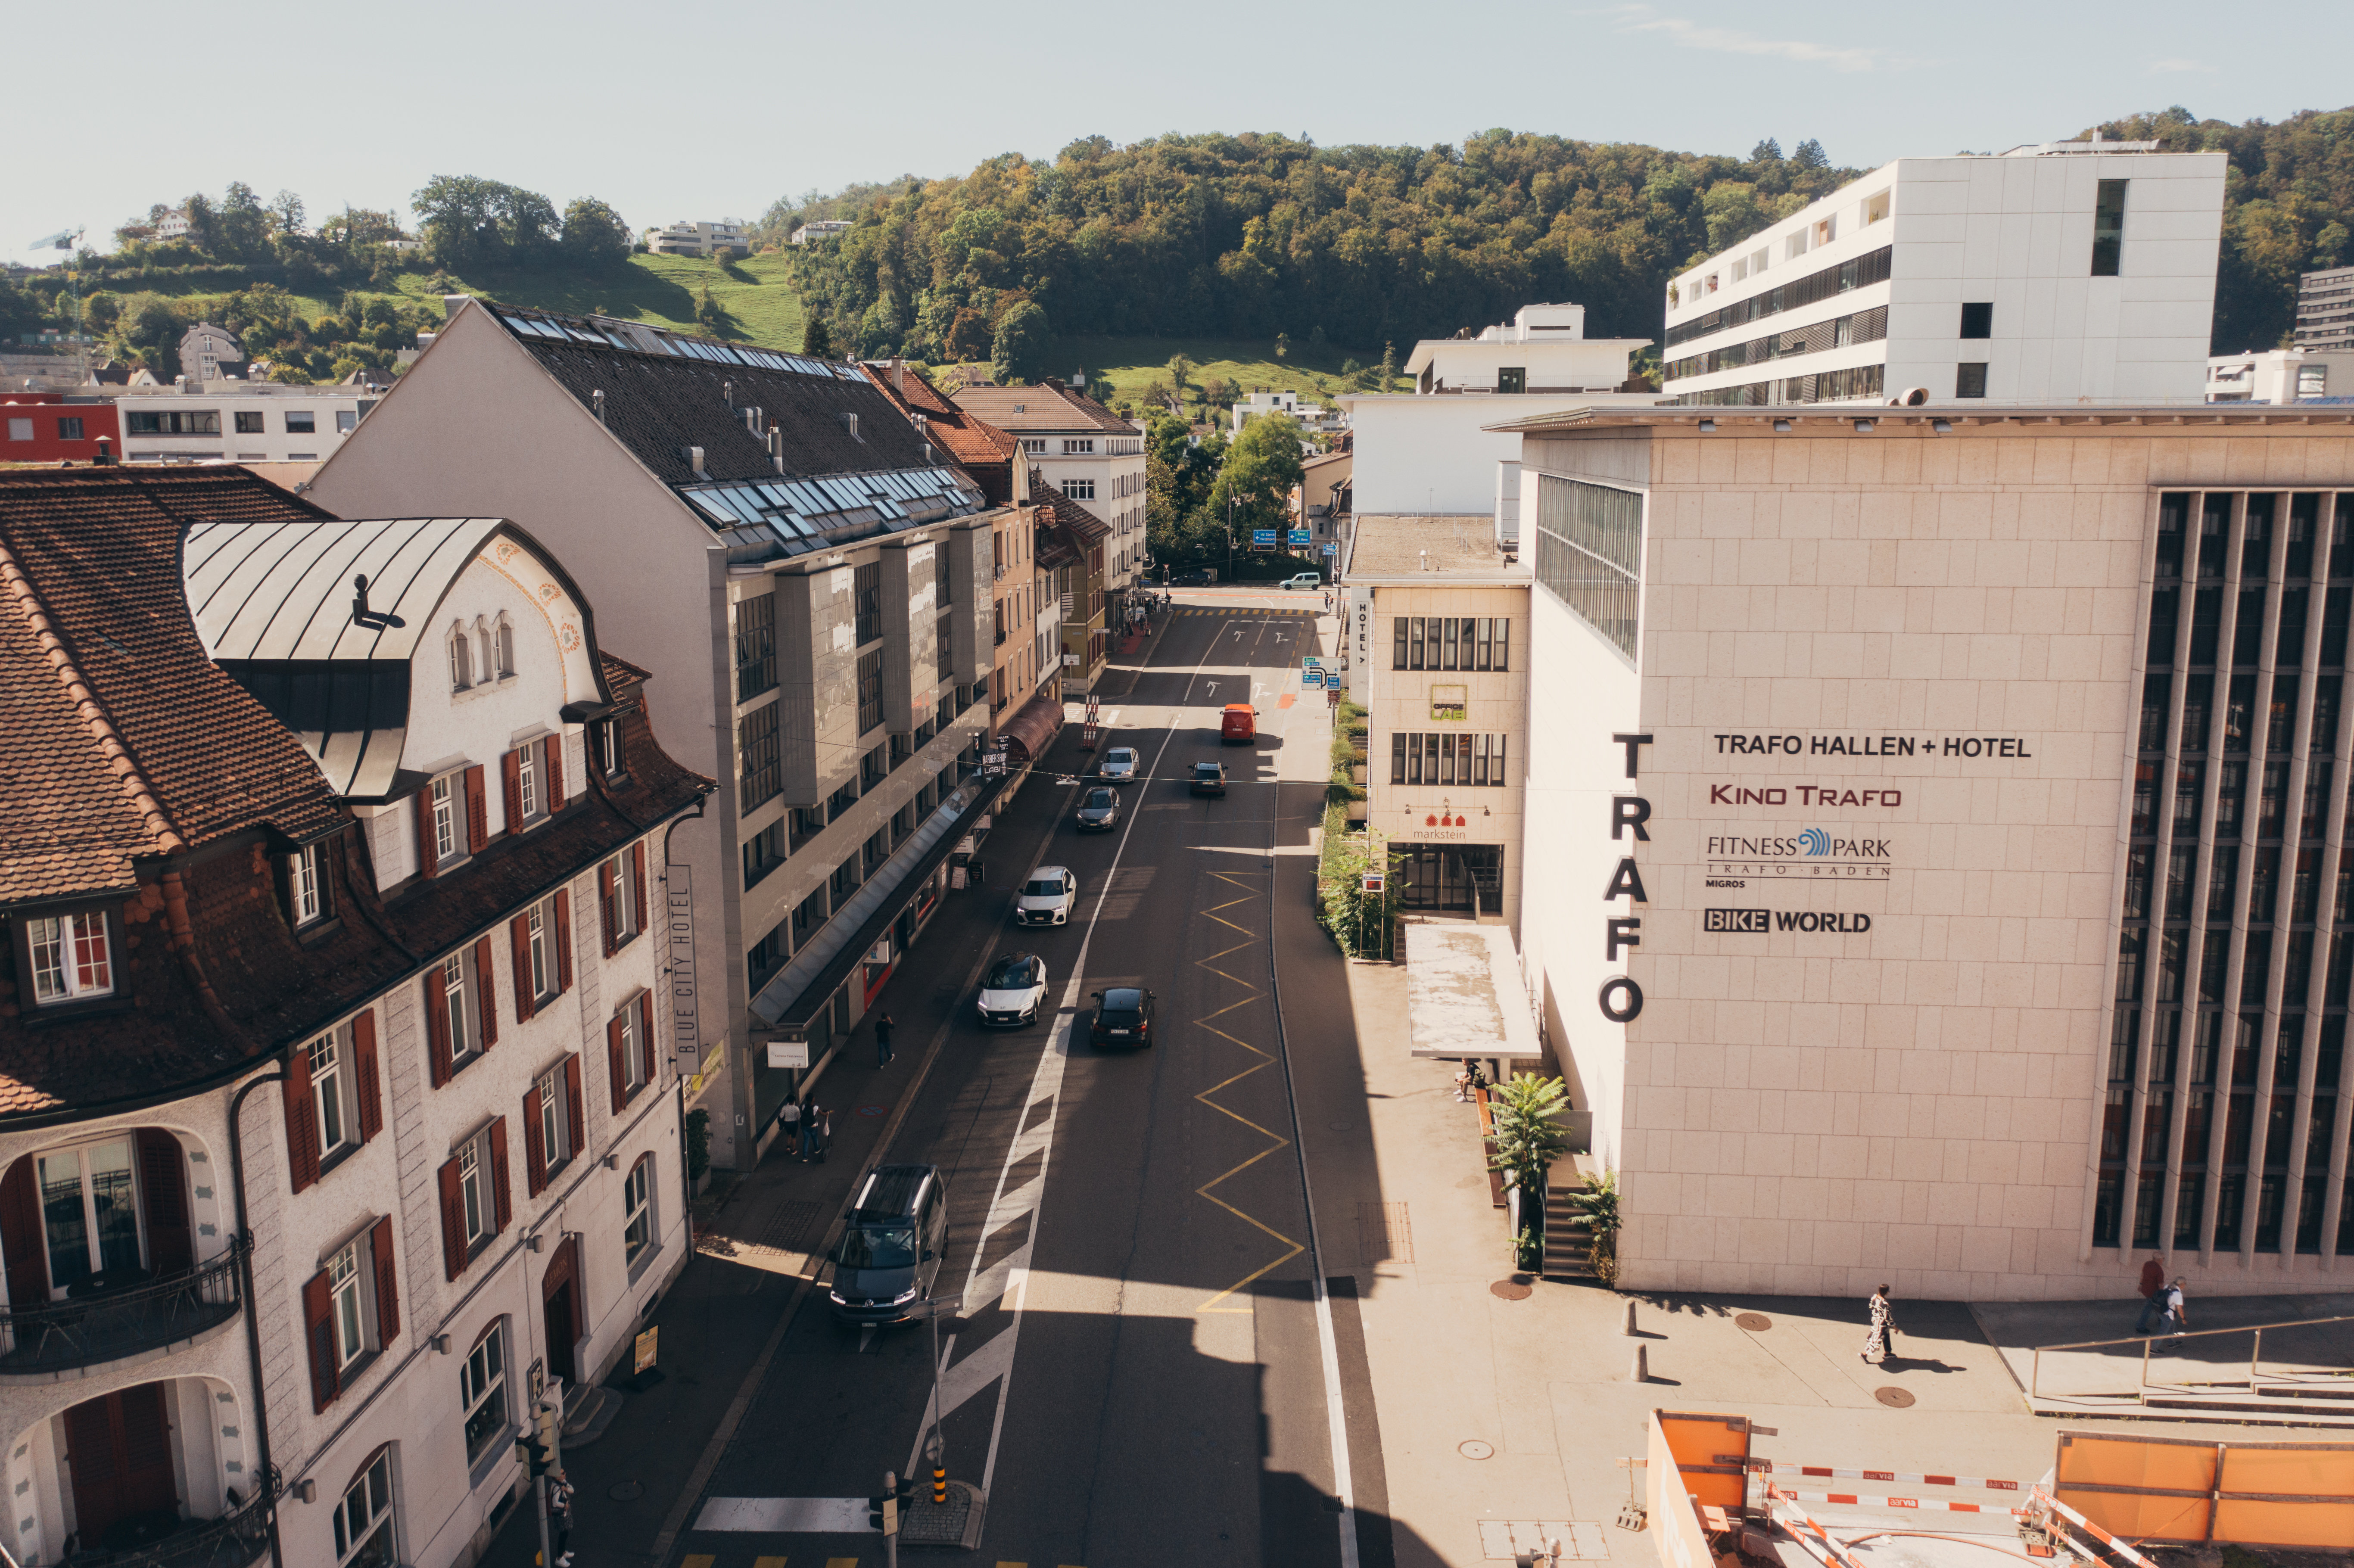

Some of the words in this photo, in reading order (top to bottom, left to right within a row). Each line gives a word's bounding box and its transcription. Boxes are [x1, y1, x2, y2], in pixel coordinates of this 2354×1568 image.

[1432, 710, 1465, 720] LAB
[1714, 734, 1802, 755] TRAFO
[1811, 736, 1915, 756] HALLEN
[1922, 740, 1936, 753] +
[1944, 737, 2031, 757] HOTEL
[983, 754, 996, 764] BARBER
[997, 753, 1007, 762] SHOP
[1414, 829, 1466, 839] markstein
[1708, 837, 1797, 856] FITNESS
[1833, 839, 1891, 857] PARK
[1598, 732, 1653, 1023] TRAFO
[1707, 864, 1787, 874] TRAFO
[1813, 865, 1890, 876] BADEN
[1706, 880, 1745, 888] MIGROS
[670, 888, 690, 944] HOTEL
[1707, 910, 1767, 931] BIKE
[1775, 912, 1871, 933] WORLD
[674, 957, 693, 996] CITY
[677, 1009, 696, 1053] BLUE
[1987, 1481, 2016, 1489] aarvia
[1890, 1499, 1916, 1507] aarvia
[1784, 1521, 1804, 1541] aarvia
